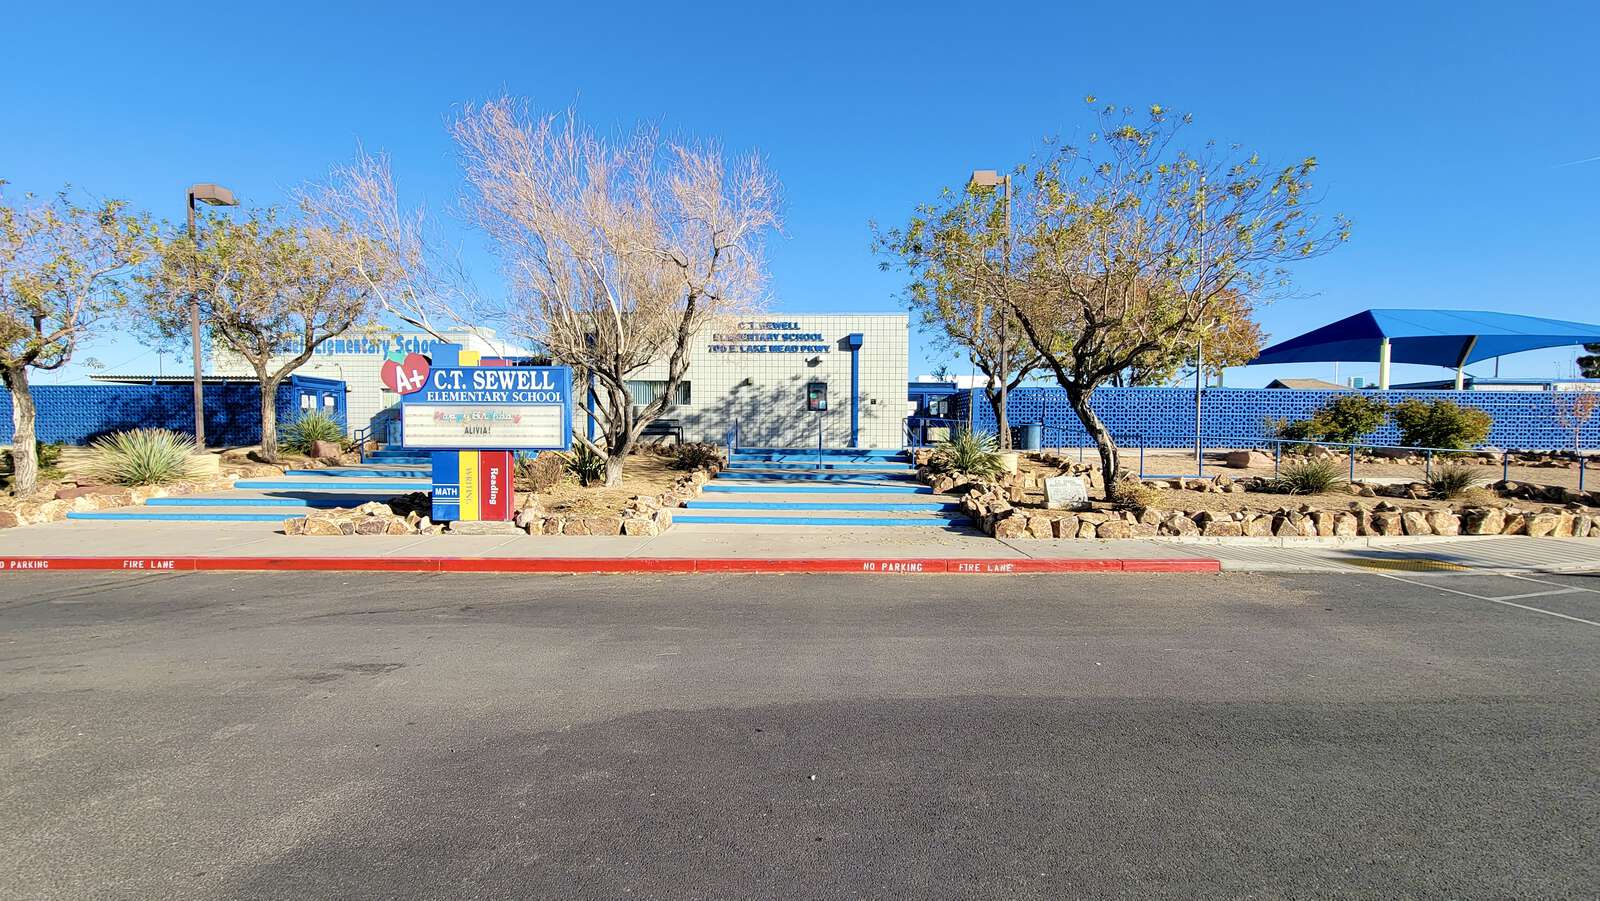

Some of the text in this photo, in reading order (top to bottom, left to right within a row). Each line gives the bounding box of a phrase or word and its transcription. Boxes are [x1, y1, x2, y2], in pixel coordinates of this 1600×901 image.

[781, 333, 824, 341] SCHOOL
[395, 335, 438, 353] Schoo
[740, 345, 767, 353] LAKE
[769, 345, 798, 353] MEAD
[395, 365, 424, 393] A+
[434, 370, 555, 390] C.T. SEWELL
[427, 391, 562, 402] ELEMENTARY SCHOOL
[464, 426, 491, 435] ALIVIA!
[488, 467, 500, 505] Reading
[435, 487, 458, 496] MATH
[10, 560, 49, 569] PARKING
[123, 560, 175, 569] FIRE LANE
[863, 562, 923, 572] NO PARKING
[959, 563, 1014, 572] FIRE LANE
